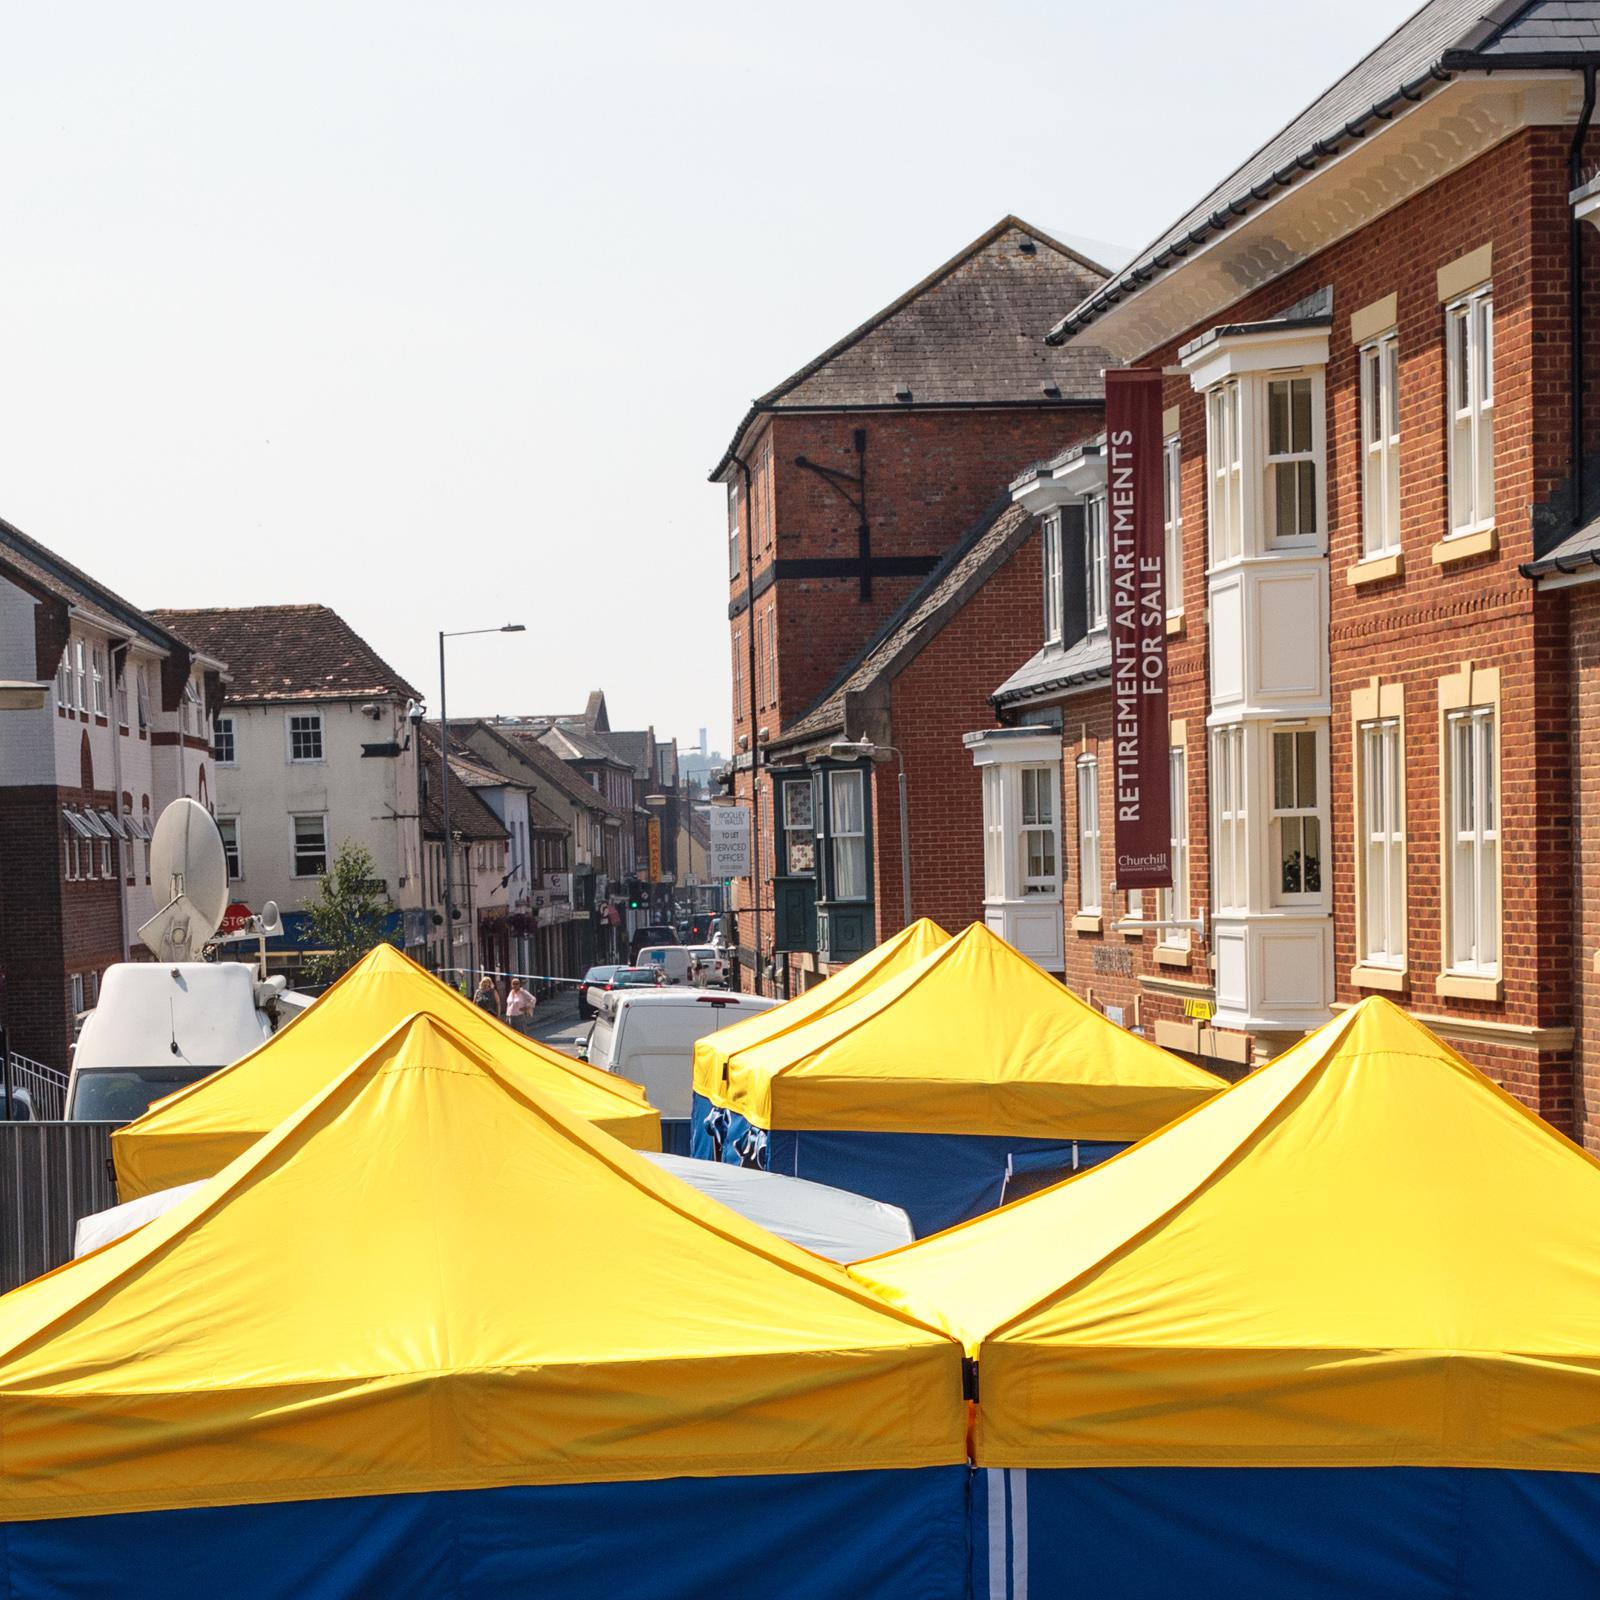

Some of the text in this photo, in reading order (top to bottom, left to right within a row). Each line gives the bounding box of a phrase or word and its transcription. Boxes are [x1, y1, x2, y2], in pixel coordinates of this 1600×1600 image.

[1111, 430, 1140, 822] RETIREMENT APARTMENTS
[1140, 556, 1164, 695] FOR SALE
[722, 831, 739, 839] TO LET
[715, 843, 747, 852] SERVICED
[717, 853, 745, 862] OFFICES
[1118, 852, 1167, 866] Churchill
[222, 916, 245, 927] STO
